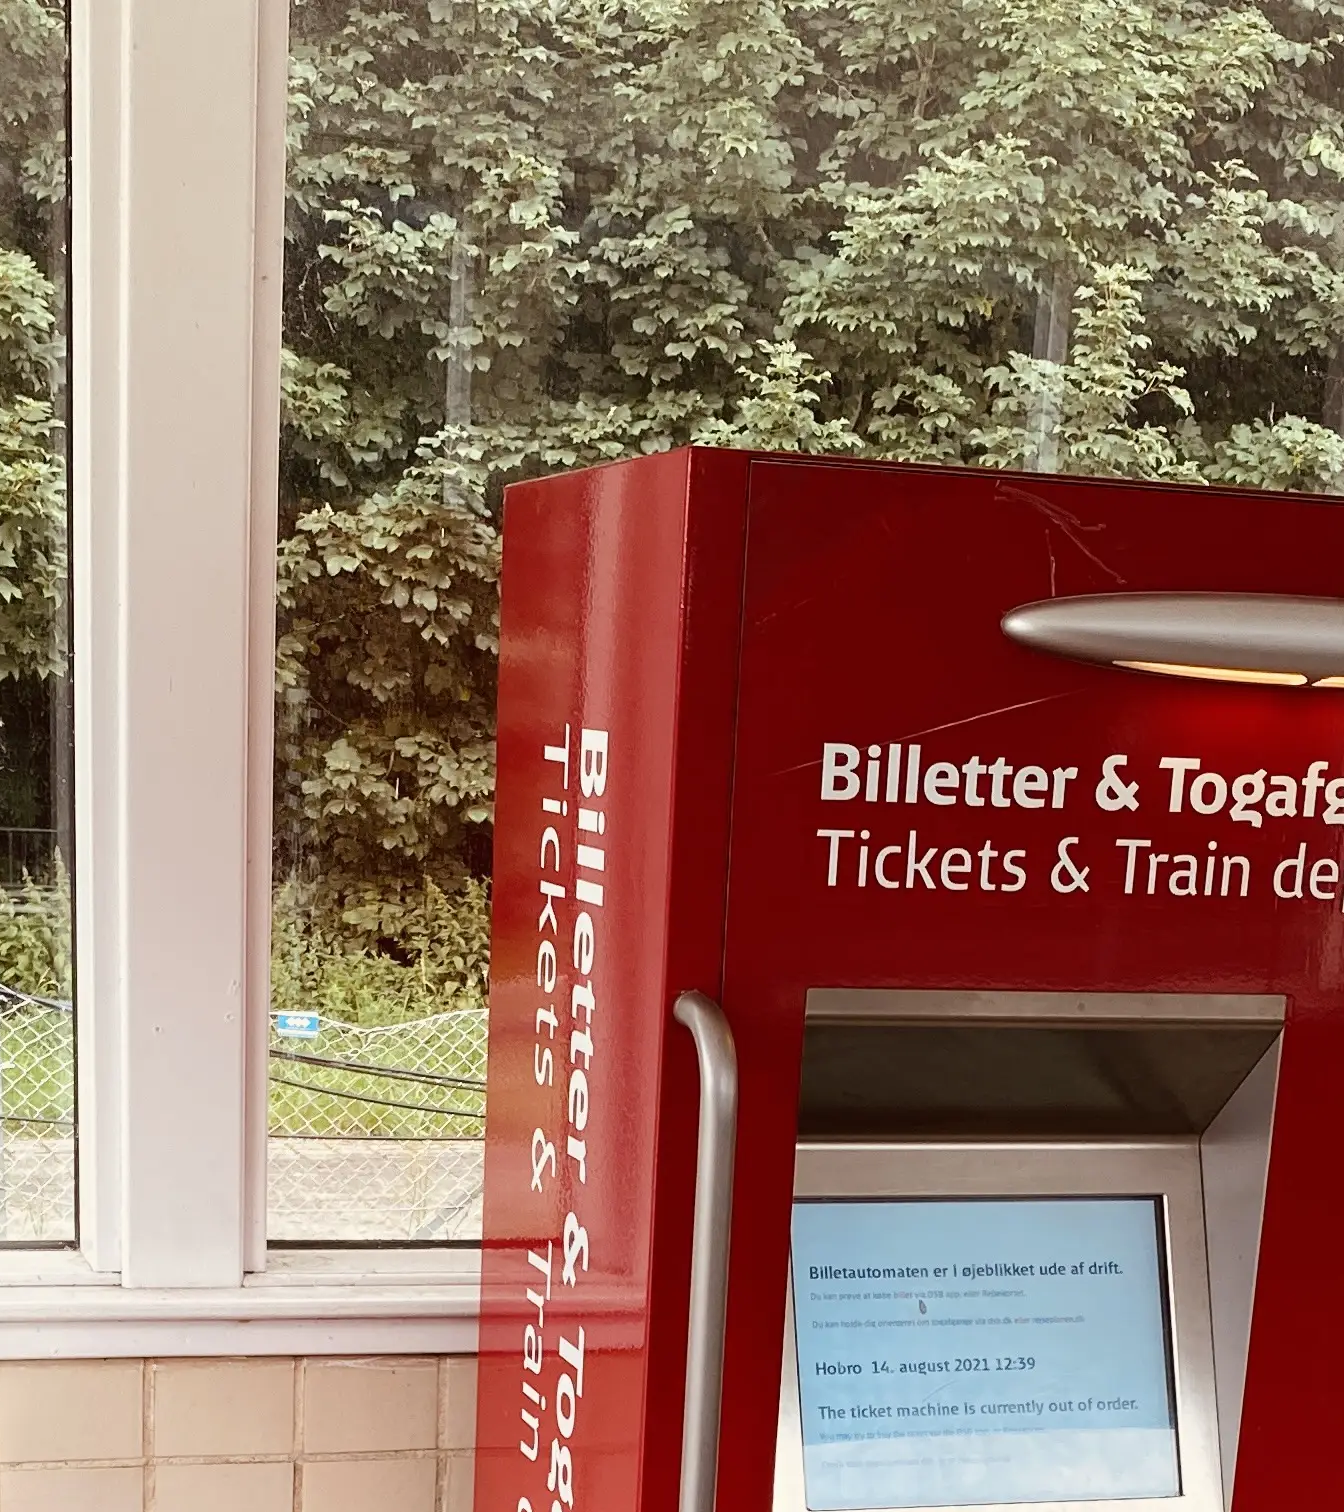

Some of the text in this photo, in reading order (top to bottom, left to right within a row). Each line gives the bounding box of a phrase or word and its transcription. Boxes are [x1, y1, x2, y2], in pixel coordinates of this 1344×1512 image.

[819, 742, 1077, 810] Billetter
[1095, 754, 1140, 811] &
[816, 829, 1026, 892] Tickets
[1051, 837, 1090, 893] &
[1115, 838, 1250, 897] Train
[533, 723, 570, 1087] Tickets
[567, 727, 609, 1184] Billetter
[530, 1127, 556, 1193] &
[562, 1210, 590, 1288] &
[809, 1266, 929, 1280] Billetautomaten
[933, 1267, 948, 1278] er
[962, 1262, 1035, 1280] øjeblikket
[1040, 1262, 1066, 1276] ude
[1071, 1261, 1085, 1275] af
[1088, 1261, 1123, 1275] drift.
[519, 1240, 553, 1462] Train
[815, 1357, 1036, 1375] Hobro 14. august 2021 12:39
[818, 1398, 1139, 1420] The ticket machine is currently out of order.
